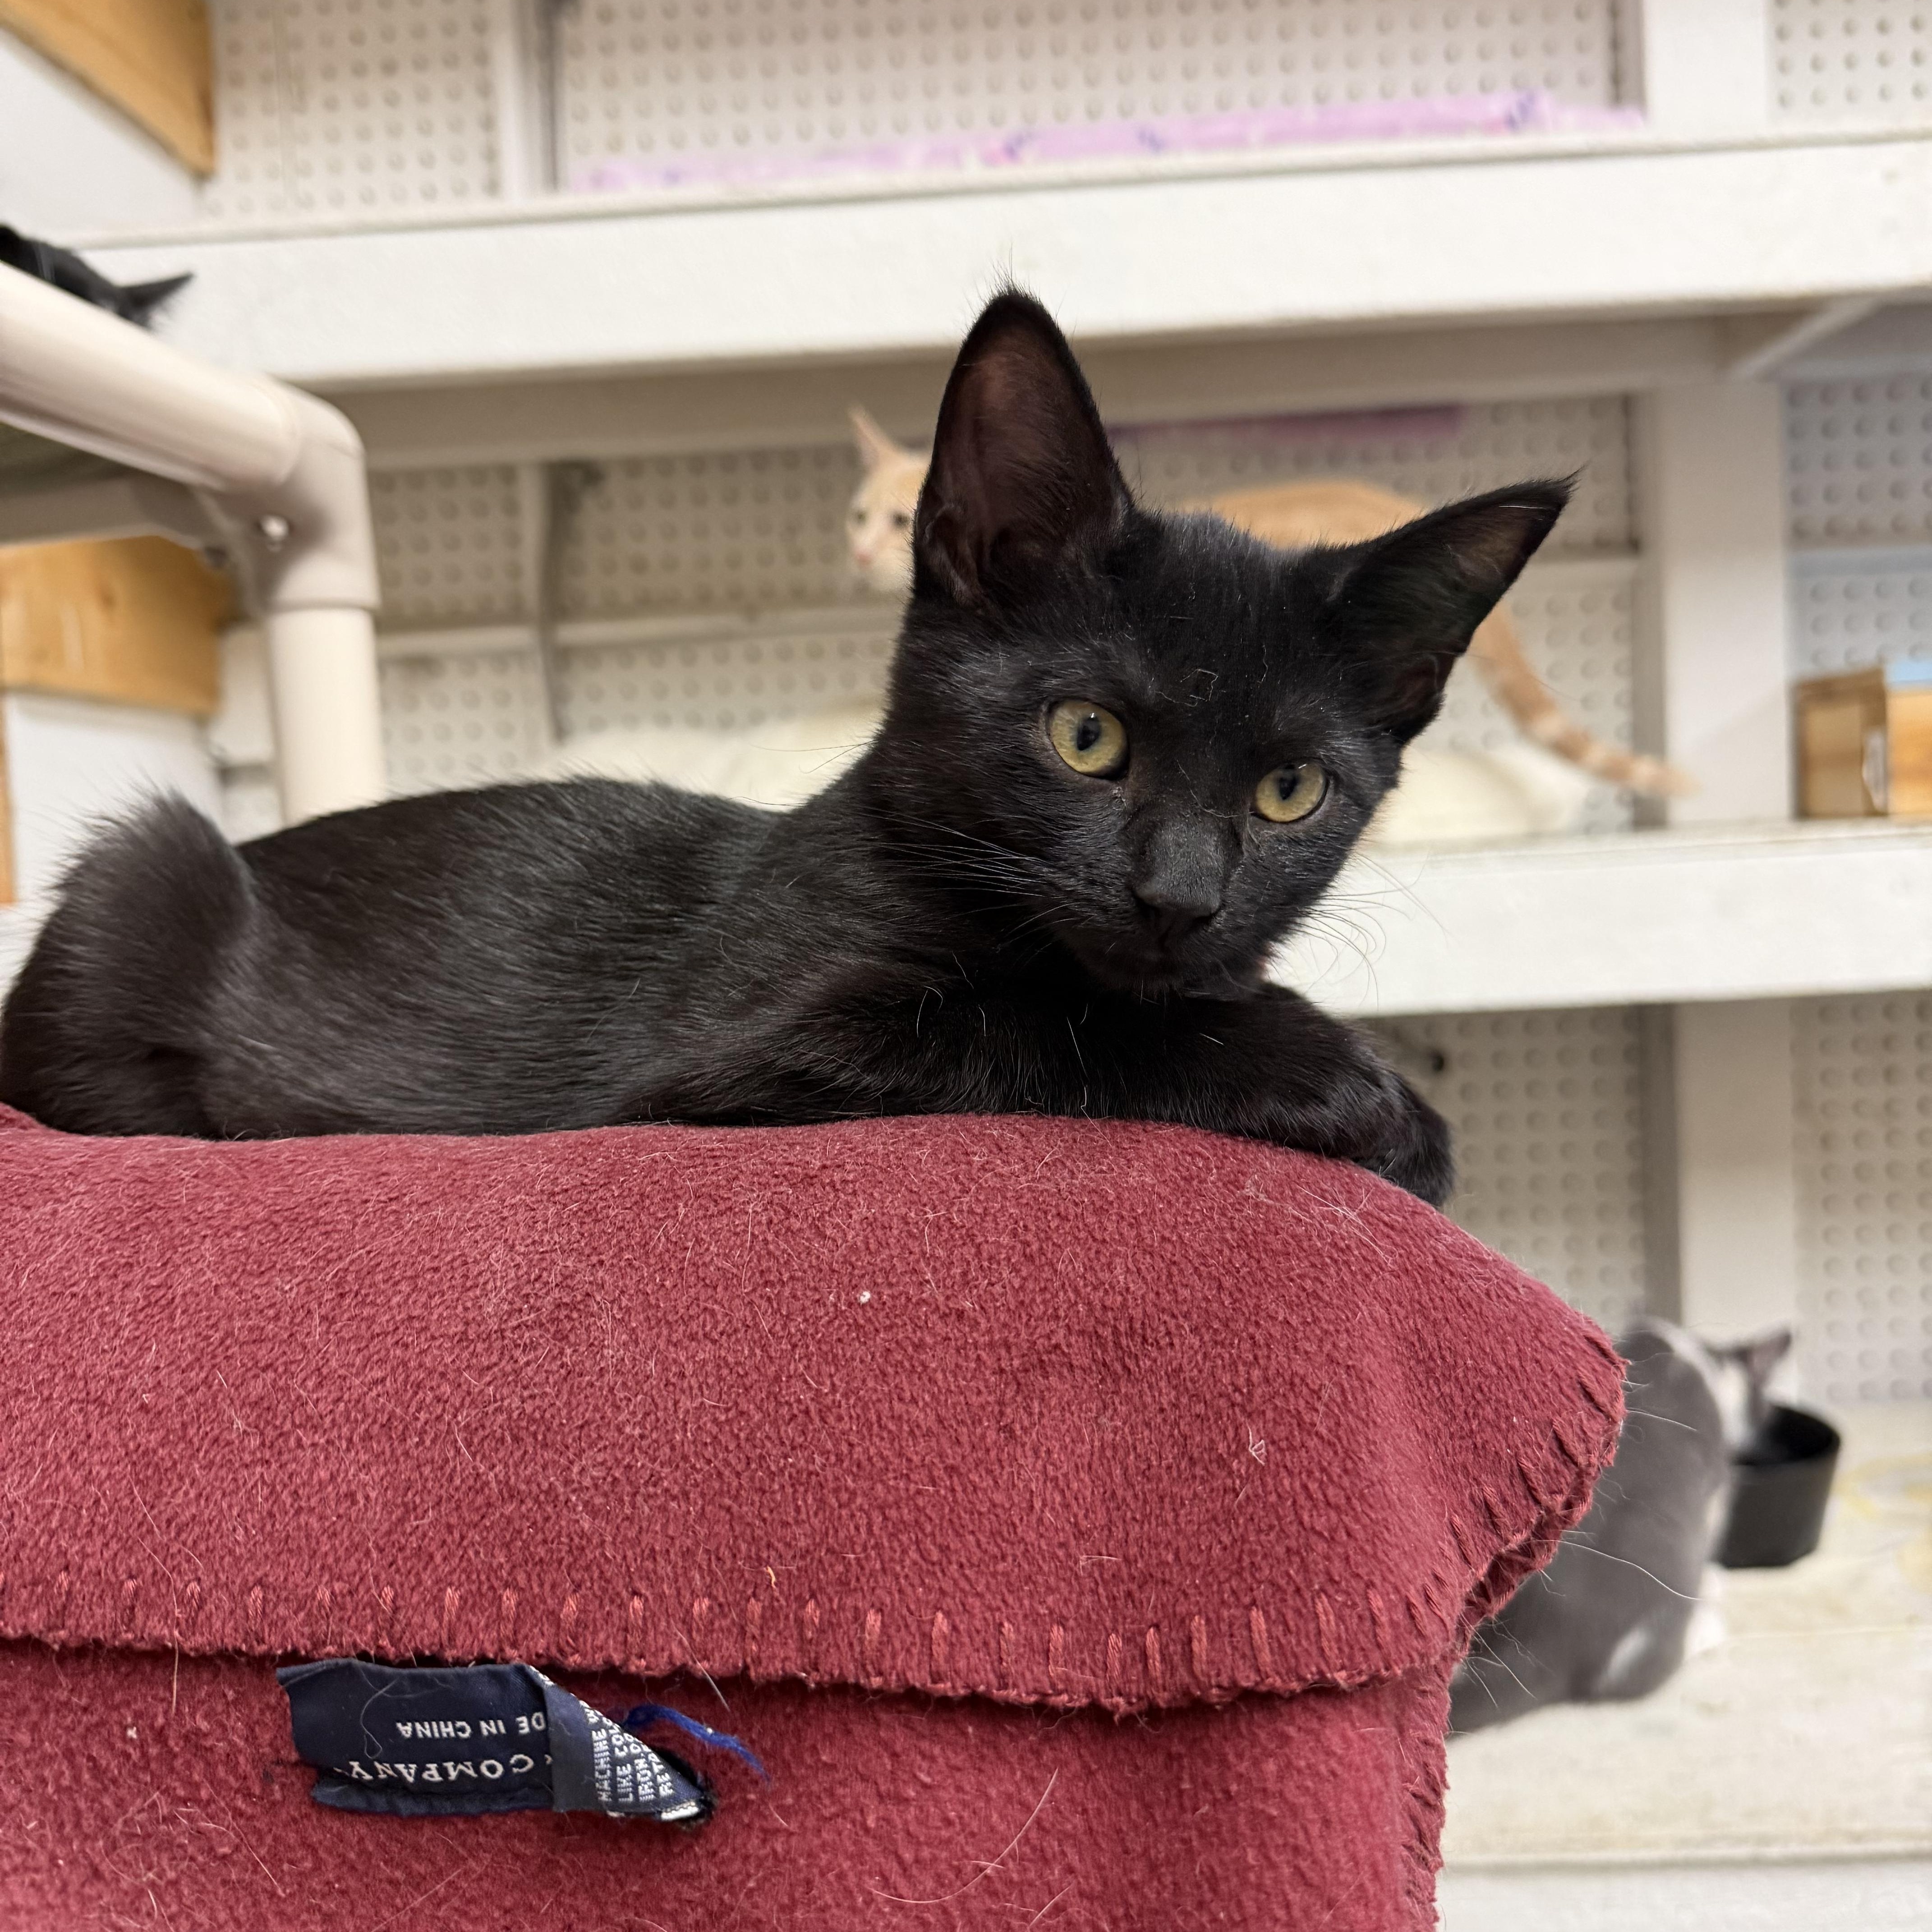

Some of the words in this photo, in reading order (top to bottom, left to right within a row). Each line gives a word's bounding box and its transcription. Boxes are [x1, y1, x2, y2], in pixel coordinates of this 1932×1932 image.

[396, 1720, 472, 1739] CHINA
[479, 1720, 506, 1737] IN
[349, 1754, 534, 1783] COMPANY
[591, 1728, 612, 1803] MACHINE
[616, 1763, 634, 1803] LIKE
